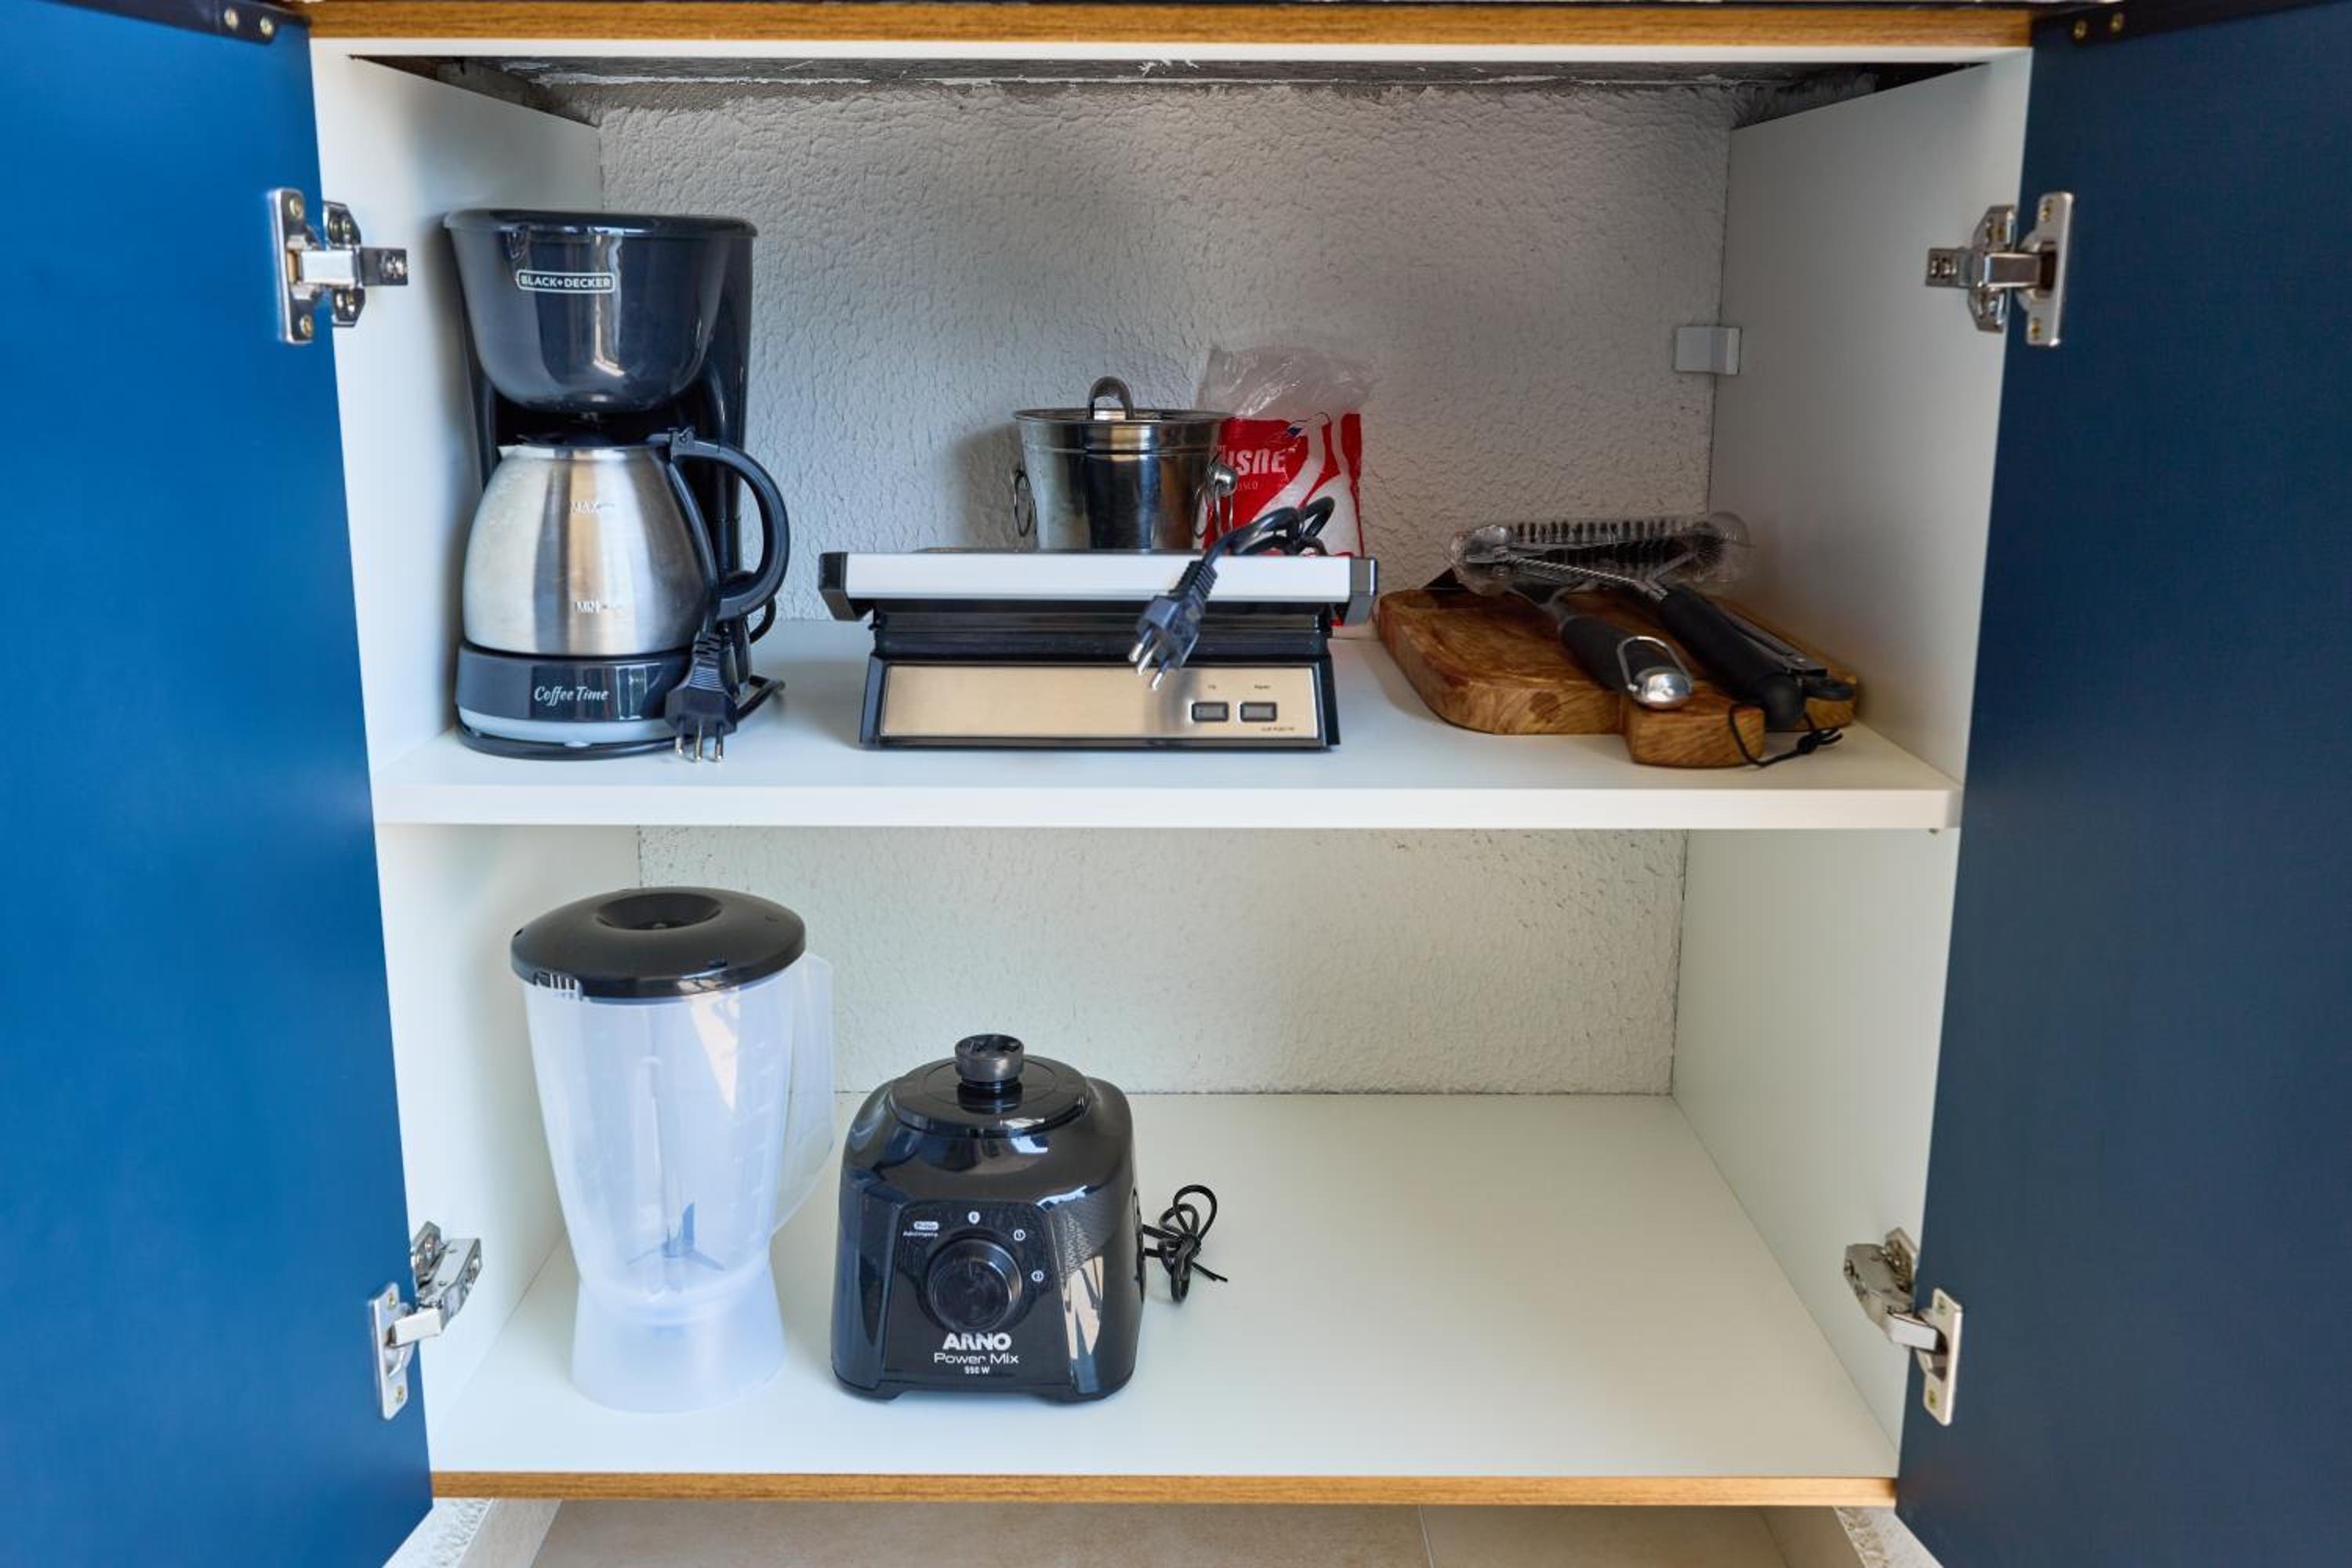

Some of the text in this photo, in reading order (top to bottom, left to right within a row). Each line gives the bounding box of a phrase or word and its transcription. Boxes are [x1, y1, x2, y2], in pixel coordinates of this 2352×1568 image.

[534, 685, 609, 706] Coffee Time
[942, 1332, 1011, 1350] ARNO
[934, 1352, 1019, 1364] Power Mix
[981, 1365, 990, 1374] W
